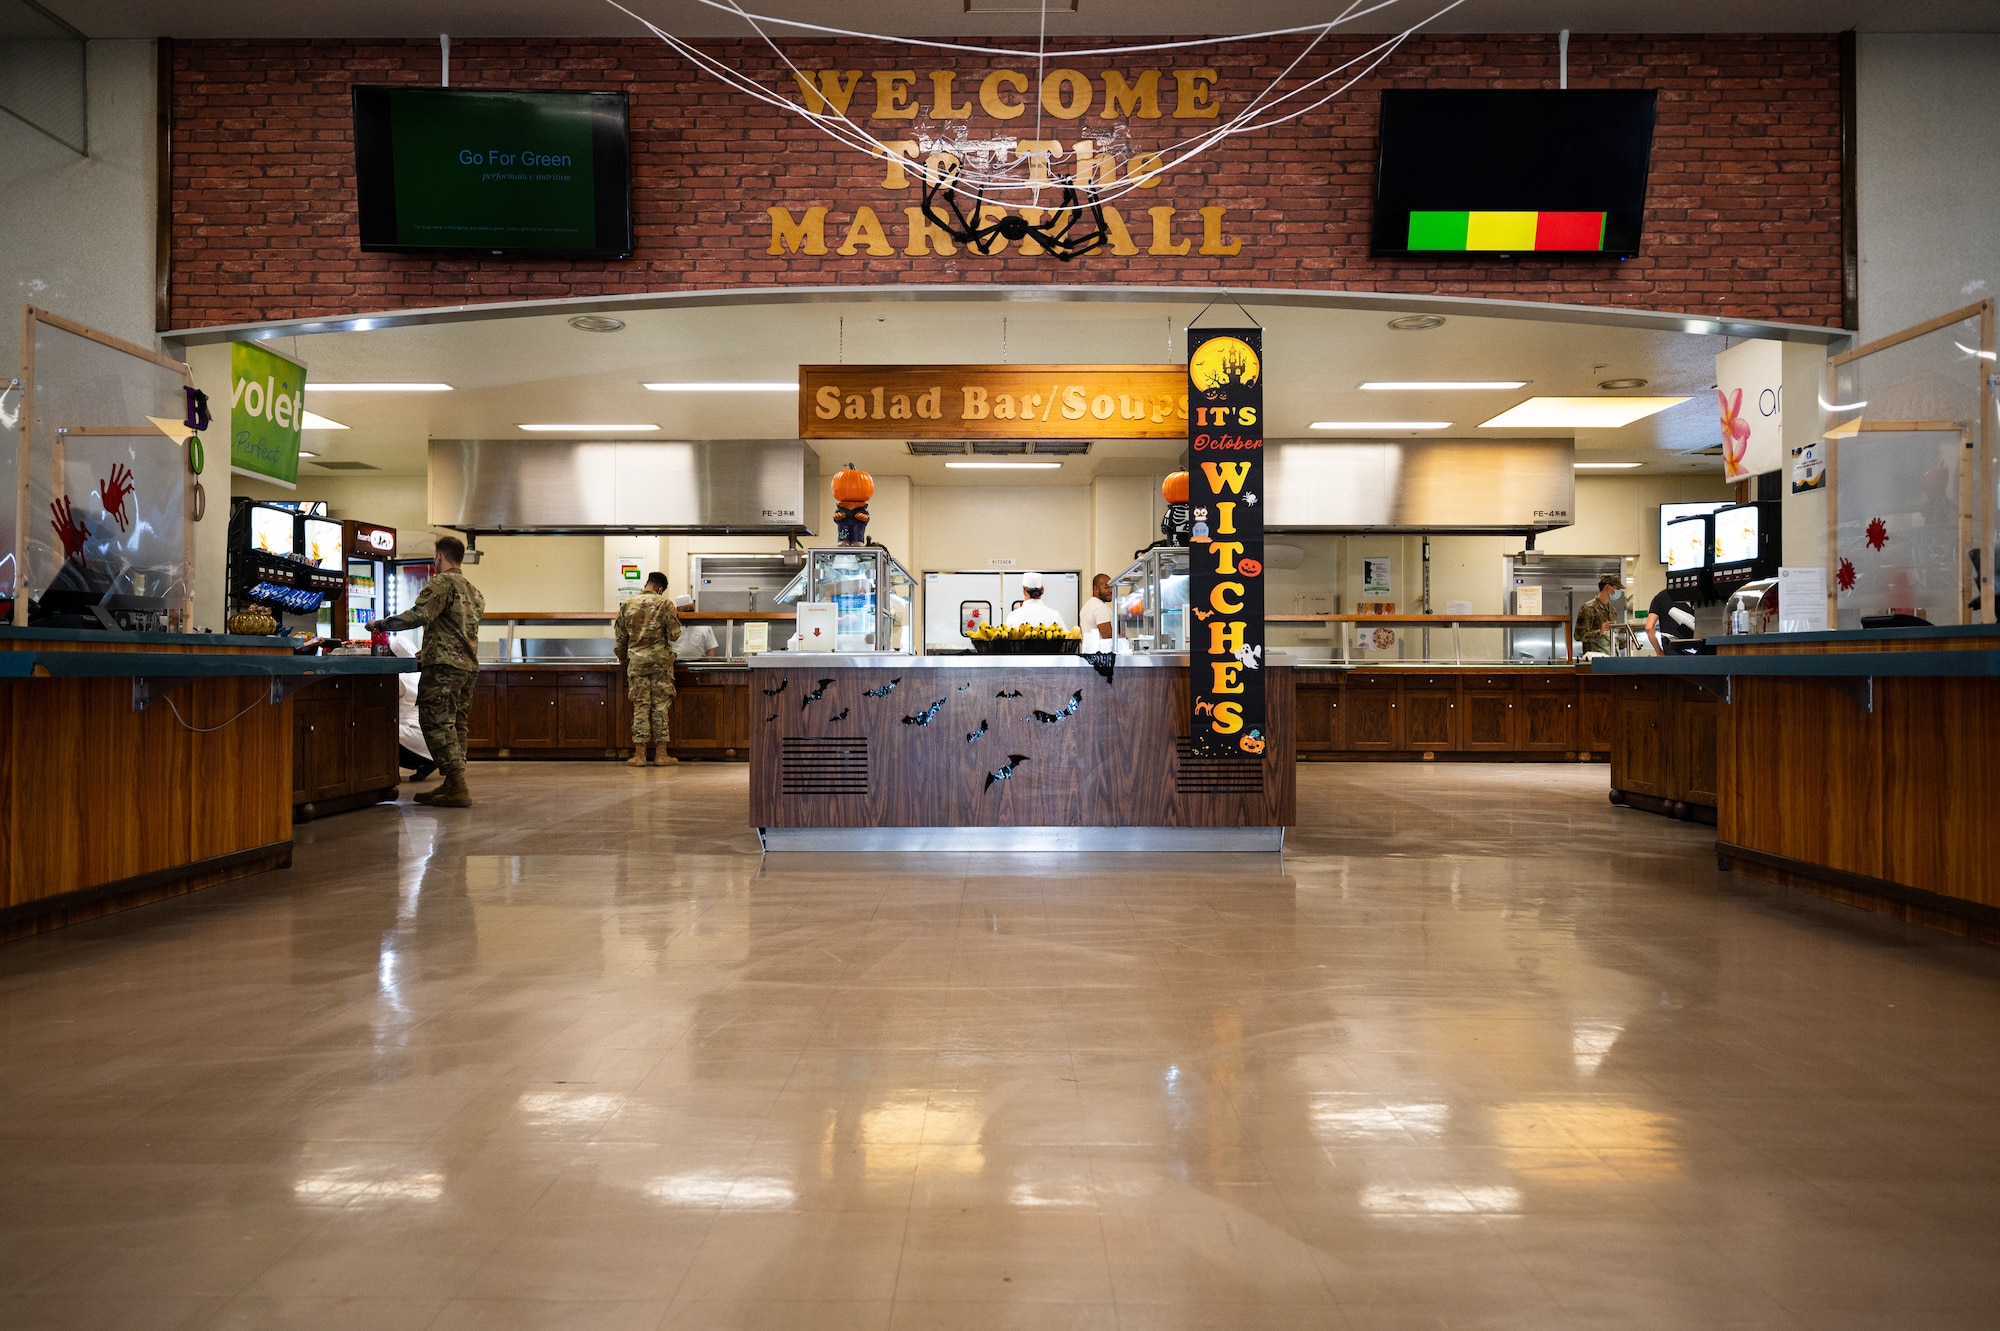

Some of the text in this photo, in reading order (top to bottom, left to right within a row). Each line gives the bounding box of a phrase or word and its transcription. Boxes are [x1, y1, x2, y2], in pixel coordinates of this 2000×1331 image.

[793, 68, 1220, 121] WELCOME
[458, 149, 572, 167] Go For Green
[872, 139, 1164, 190] To The
[482, 172, 572, 182] performance nutrition
[814, 385, 943, 420] Salad
[1196, 406, 1257, 427] IT'S
[235, 430, 280, 463] Perfect
[1193, 434, 1263, 451] October
